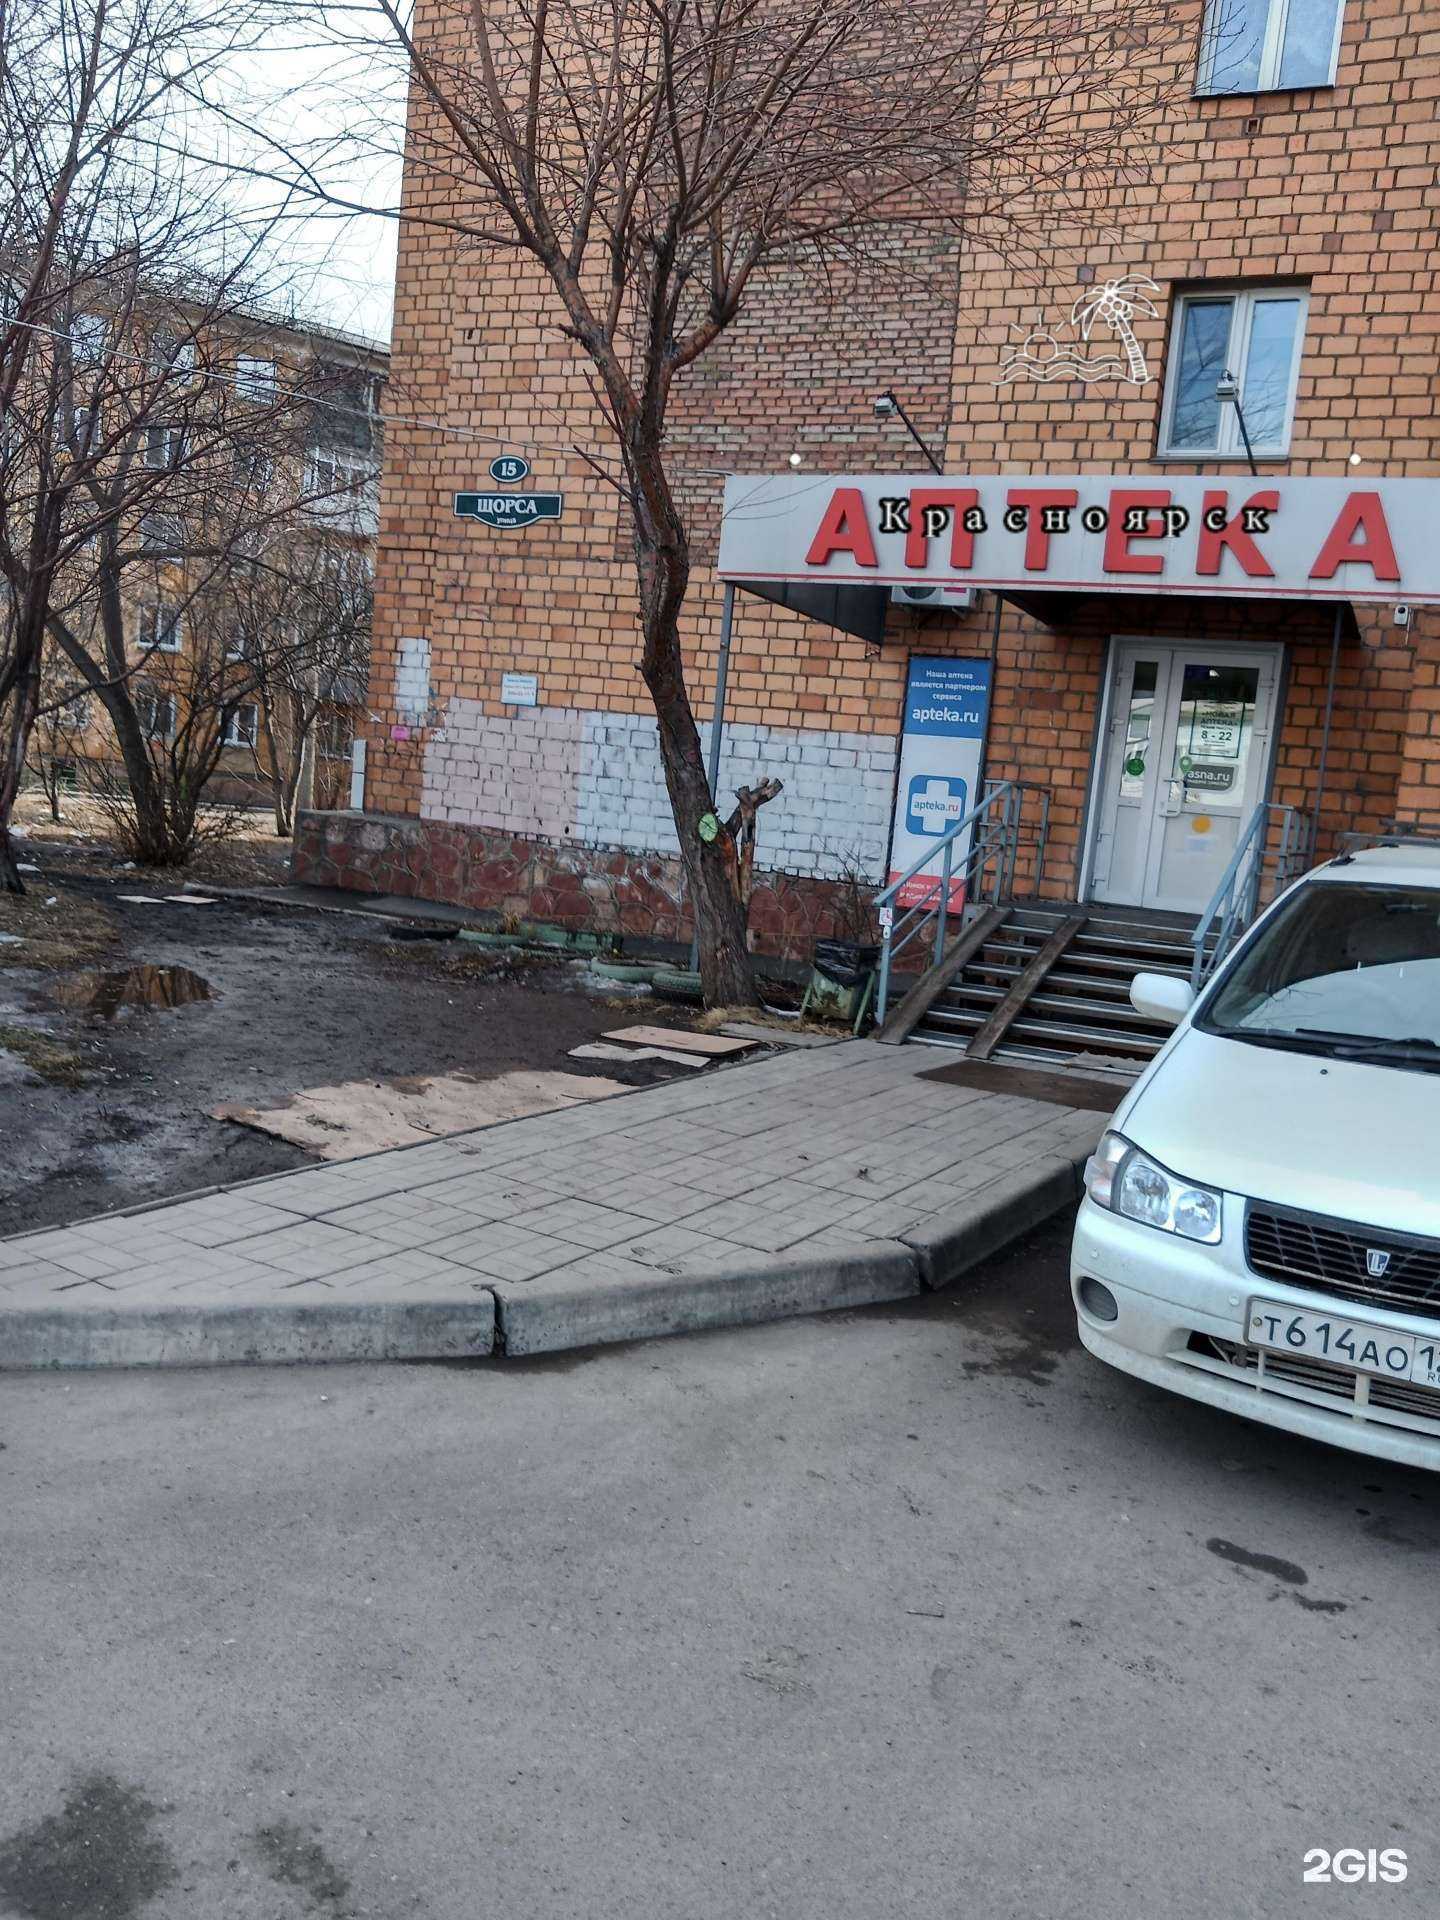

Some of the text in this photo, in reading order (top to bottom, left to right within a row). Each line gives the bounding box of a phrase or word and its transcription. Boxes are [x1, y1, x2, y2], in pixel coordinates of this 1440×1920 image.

[501, 462, 517, 476] 15
[477, 498, 538, 515] ЩОРСА
[805, 488, 1401, 580] АПТЕКА
[926, 670, 974, 680] Наша аптека
[911, 681, 987, 692] является партнером
[932, 693, 962, 701] сервиса
[912, 707, 979, 723] apteka.ru
[1201, 730, 1208, 739] 8
[1219, 731, 1232, 741] 22
[1187, 770, 1230, 782] asna.ru
[914, 801, 959, 812] apteka.ru
